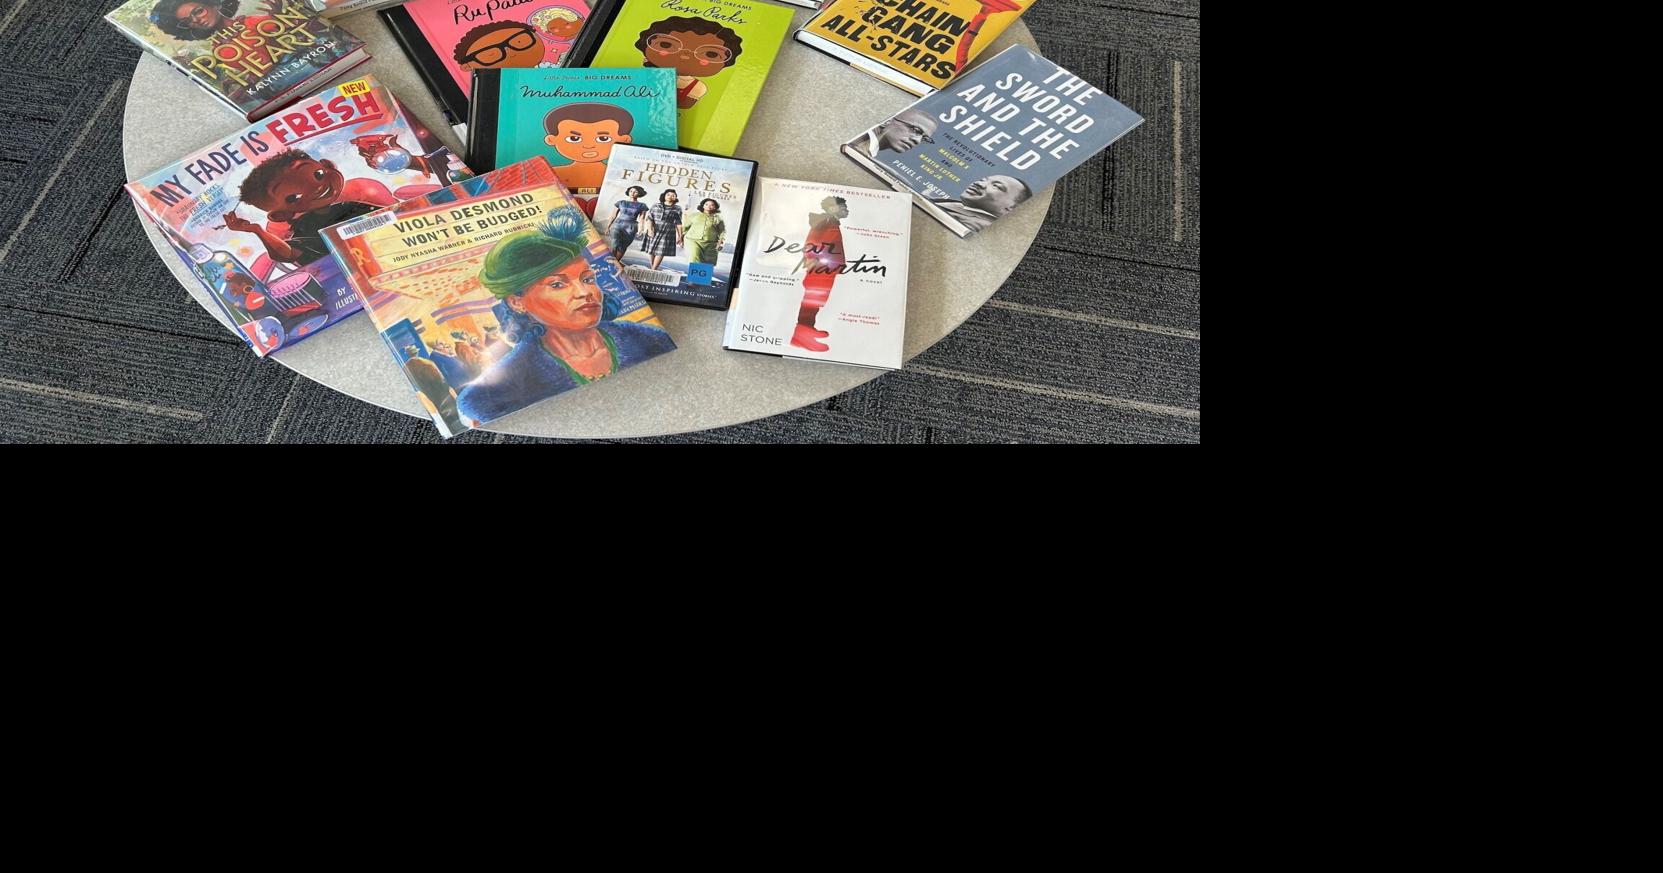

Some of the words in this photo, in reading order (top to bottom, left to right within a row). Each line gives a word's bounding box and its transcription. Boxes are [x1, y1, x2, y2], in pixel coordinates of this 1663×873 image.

[661, 0, 702, 14] Rosa
[703, 6, 747, 24] Parks
[723, 1, 752, 11] DREAMS
[191, 5, 309, 80] POISON
[207, 21, 247, 45] THIS
[862, 6, 955, 55] GANG
[226, 22, 317, 86] HEART
[821, 14, 956, 80] ALL-STARS
[246, 64, 291, 96] KALYNN
[291, 41, 335, 69] BAYRON
[342, 82, 366, 95] NEW
[519, 85, 622, 98] Muhammad
[623, 85, 661, 98] Ali
[1041, 66, 1103, 106] THE
[995, 72, 1095, 134] SWORD
[956, 83, 1019, 129] AND
[1020, 117, 1080, 160] THE
[939, 105, 1041, 171] SHIELD
[150, 174, 192, 208] MY
[185, 143, 246, 185] FADE
[240, 130, 270, 157] IS
[265, 93, 382, 144] FRESH
[938, 148, 965, 167] MALCOLM
[949, 145, 966, 158] LIVES
[645, 162, 713, 180] HIDDEN
[919, 152, 939, 169] MARTIN
[939, 166, 961, 184] LUTHER
[920, 163, 934, 175] KING
[940, 159, 953, 168] AND
[621, 168, 731, 194] FIGURES
[892, 159, 917, 178] PENIEL
[922, 180, 951, 200] JOSEPH
[823, 186, 844, 194] TIMES
[846, 190, 891, 199] BESTSELLER
[393, 213, 447, 233] VIOLA
[450, 193, 534, 221] DESMOND
[402, 228, 450, 248] WON'T
[453, 222, 475, 236] BE
[478, 205, 543, 230] BUDGED!
[393, 254, 409, 263] JODY
[410, 248, 438, 258] NYASHA
[437, 240, 466, 252] WARNER
[473, 231, 503, 242] RICHARD
[763, 236, 841, 254] Dear
[691, 268, 707, 278] PG
[791, 254, 887, 278] Martin
[336, 286, 346, 297] BY
[652, 286, 696, 297] INSPIRING
[740, 334, 782, 346] STONE
[742, 323, 764, 334] NIC
